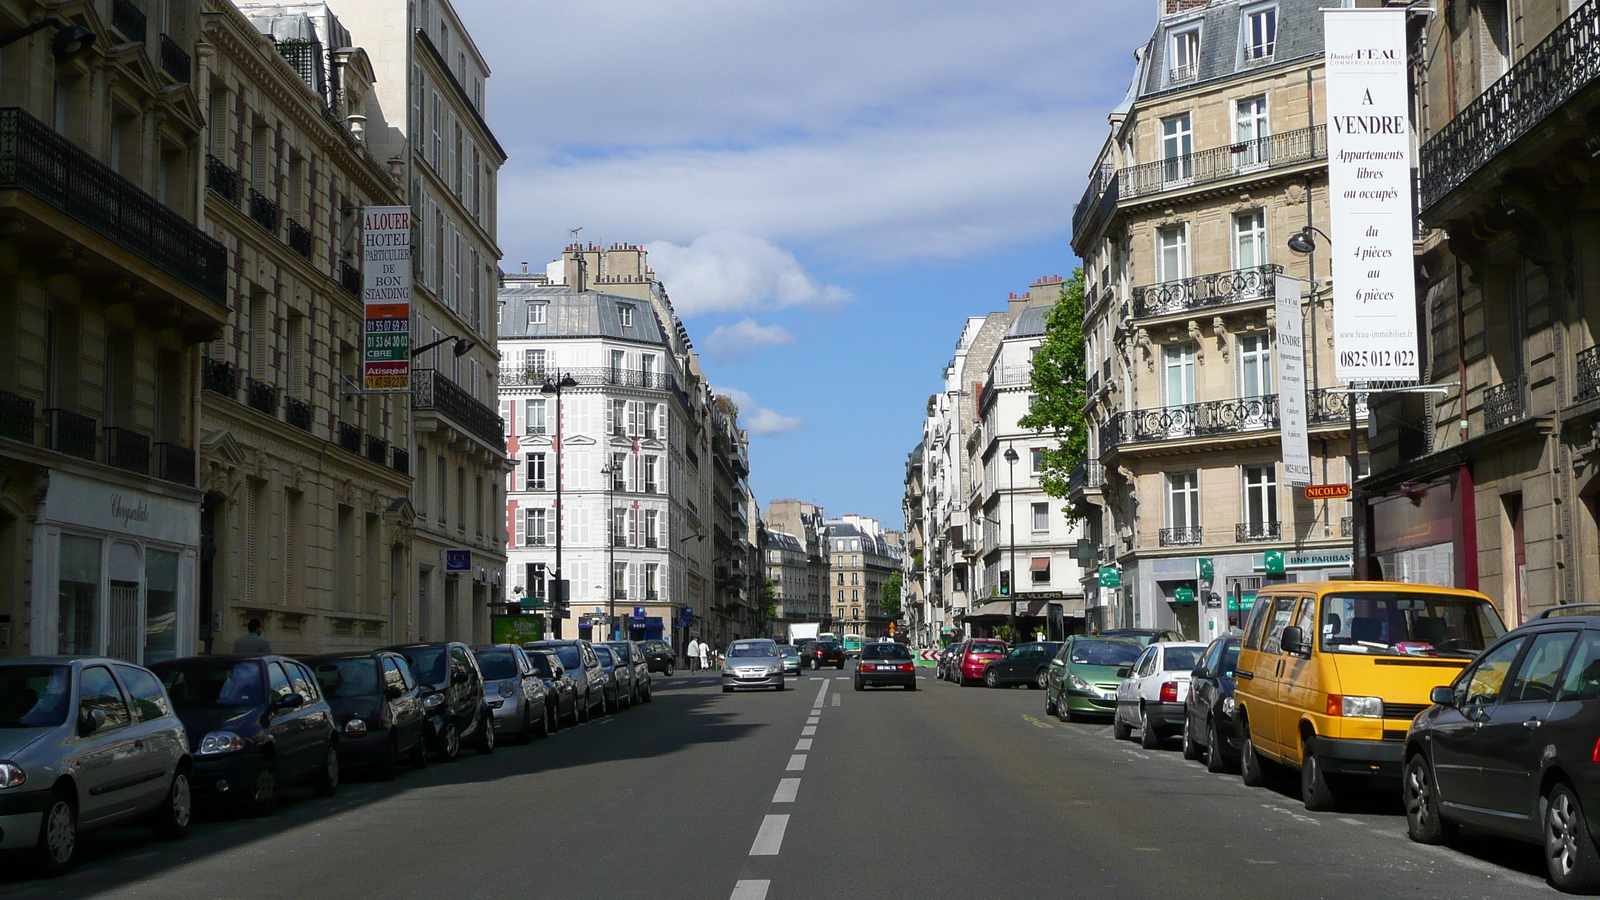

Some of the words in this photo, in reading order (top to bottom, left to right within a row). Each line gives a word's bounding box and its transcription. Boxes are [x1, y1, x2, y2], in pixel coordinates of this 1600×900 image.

[1357, 49, 1401, 60] FEAU
[1362, 87, 1374, 106] A
[1333, 115, 1405, 134] VENDRE
[1336, 148, 1405, 163] Appartements
[1356, 167, 1384, 179] libres
[1343, 190, 1356, 199] ou
[1359, 187, 1398, 202] occupés
[364, 213, 372, 230] A
[373, 212, 409, 231] LOUER
[1365, 225, 1379, 237] du
[365, 233, 409, 247] HOTEL
[365, 249, 410, 262] PARTICULIER
[1353, 246, 1360, 258] 4
[1361, 245, 1393, 261] pièces
[382, 264, 396, 274] DE
[1367, 269, 1380, 279] au
[375, 276, 401, 287] BON
[365, 287, 409, 300] STANDING
[1355, 288, 1362, 301] 6
[1363, 288, 1395, 304] pièces
[1278, 333, 1301, 347] VENDRE
[1339, 329, 1413, 339] www.feau-immobilier.fr
[367, 350, 393, 358] CBRE
[1340, 350, 1368, 367] 0825
[1370, 350, 1391, 367] 012
[1394, 350, 1415, 367] 022
[1308, 486, 1347, 497] NICOLAS
[1290, 556, 1309, 564] BNP
[1311, 554, 1351, 563] PARIBAS
